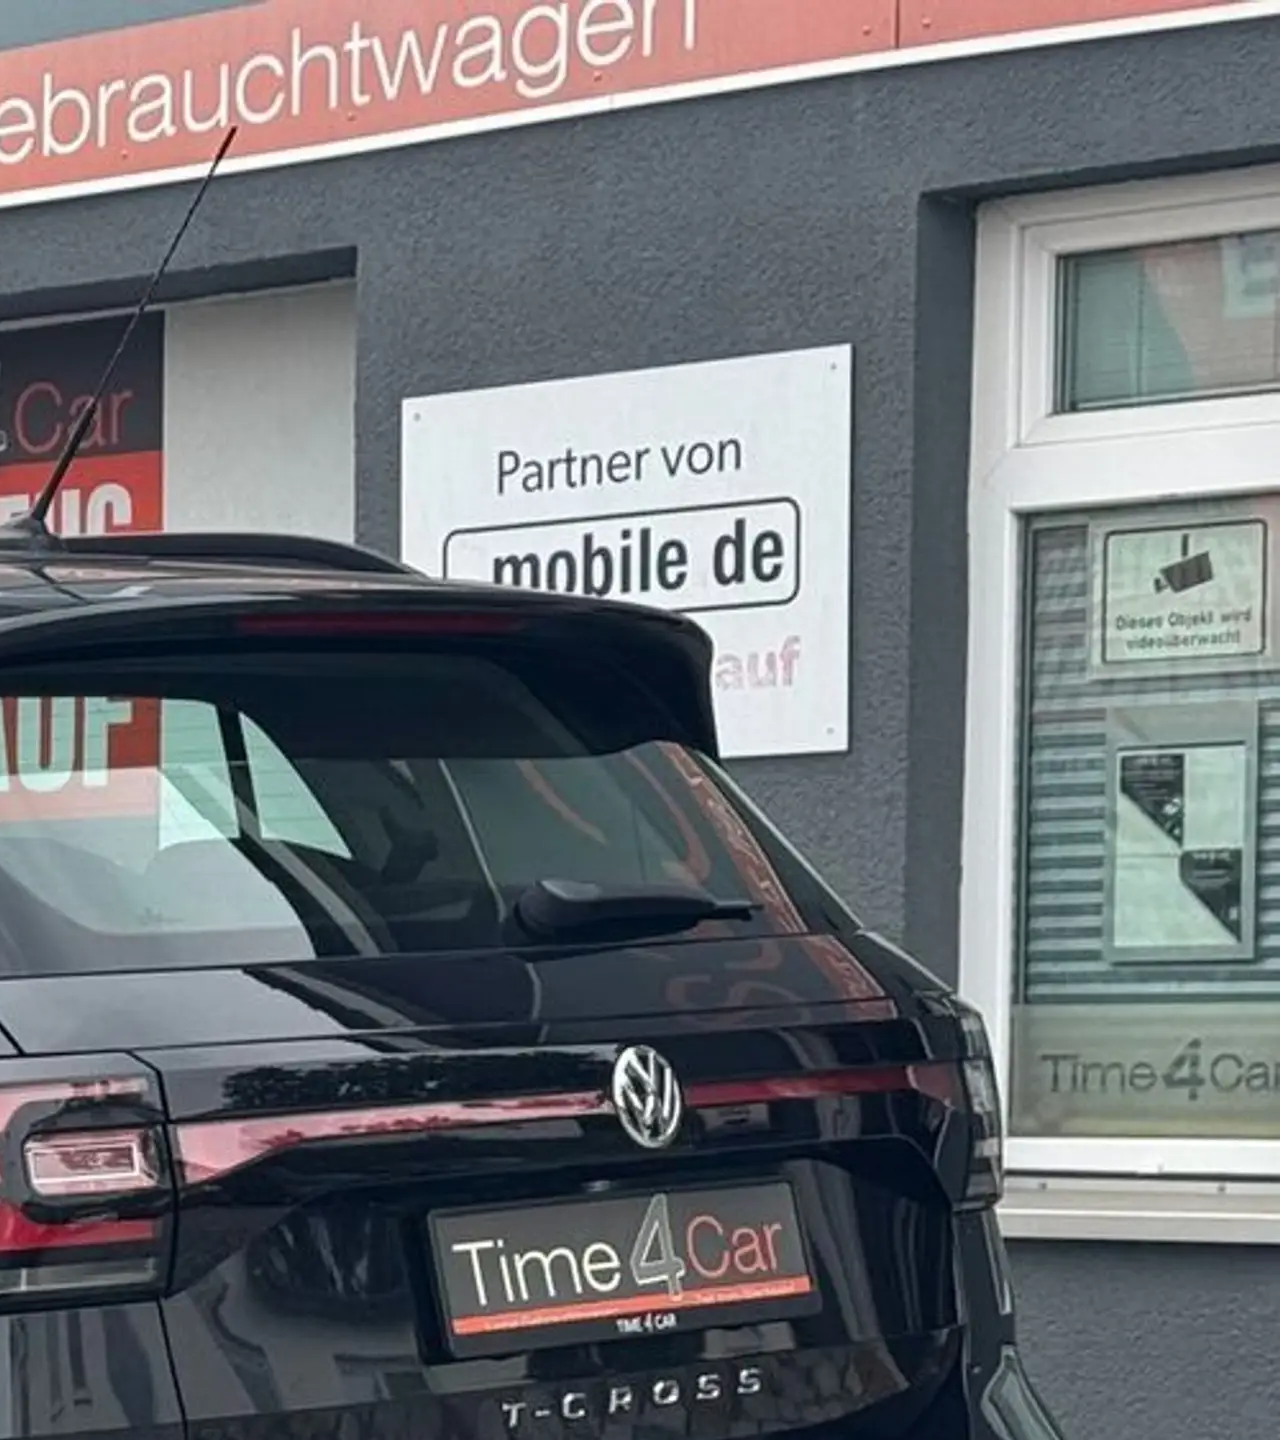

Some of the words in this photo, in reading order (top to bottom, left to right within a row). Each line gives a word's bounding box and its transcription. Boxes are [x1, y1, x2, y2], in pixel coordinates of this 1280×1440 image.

[496, 447, 650, 496] Partner
[661, 436, 742, 476] von
[502, 1367, 763, 1428] T-CROSS
